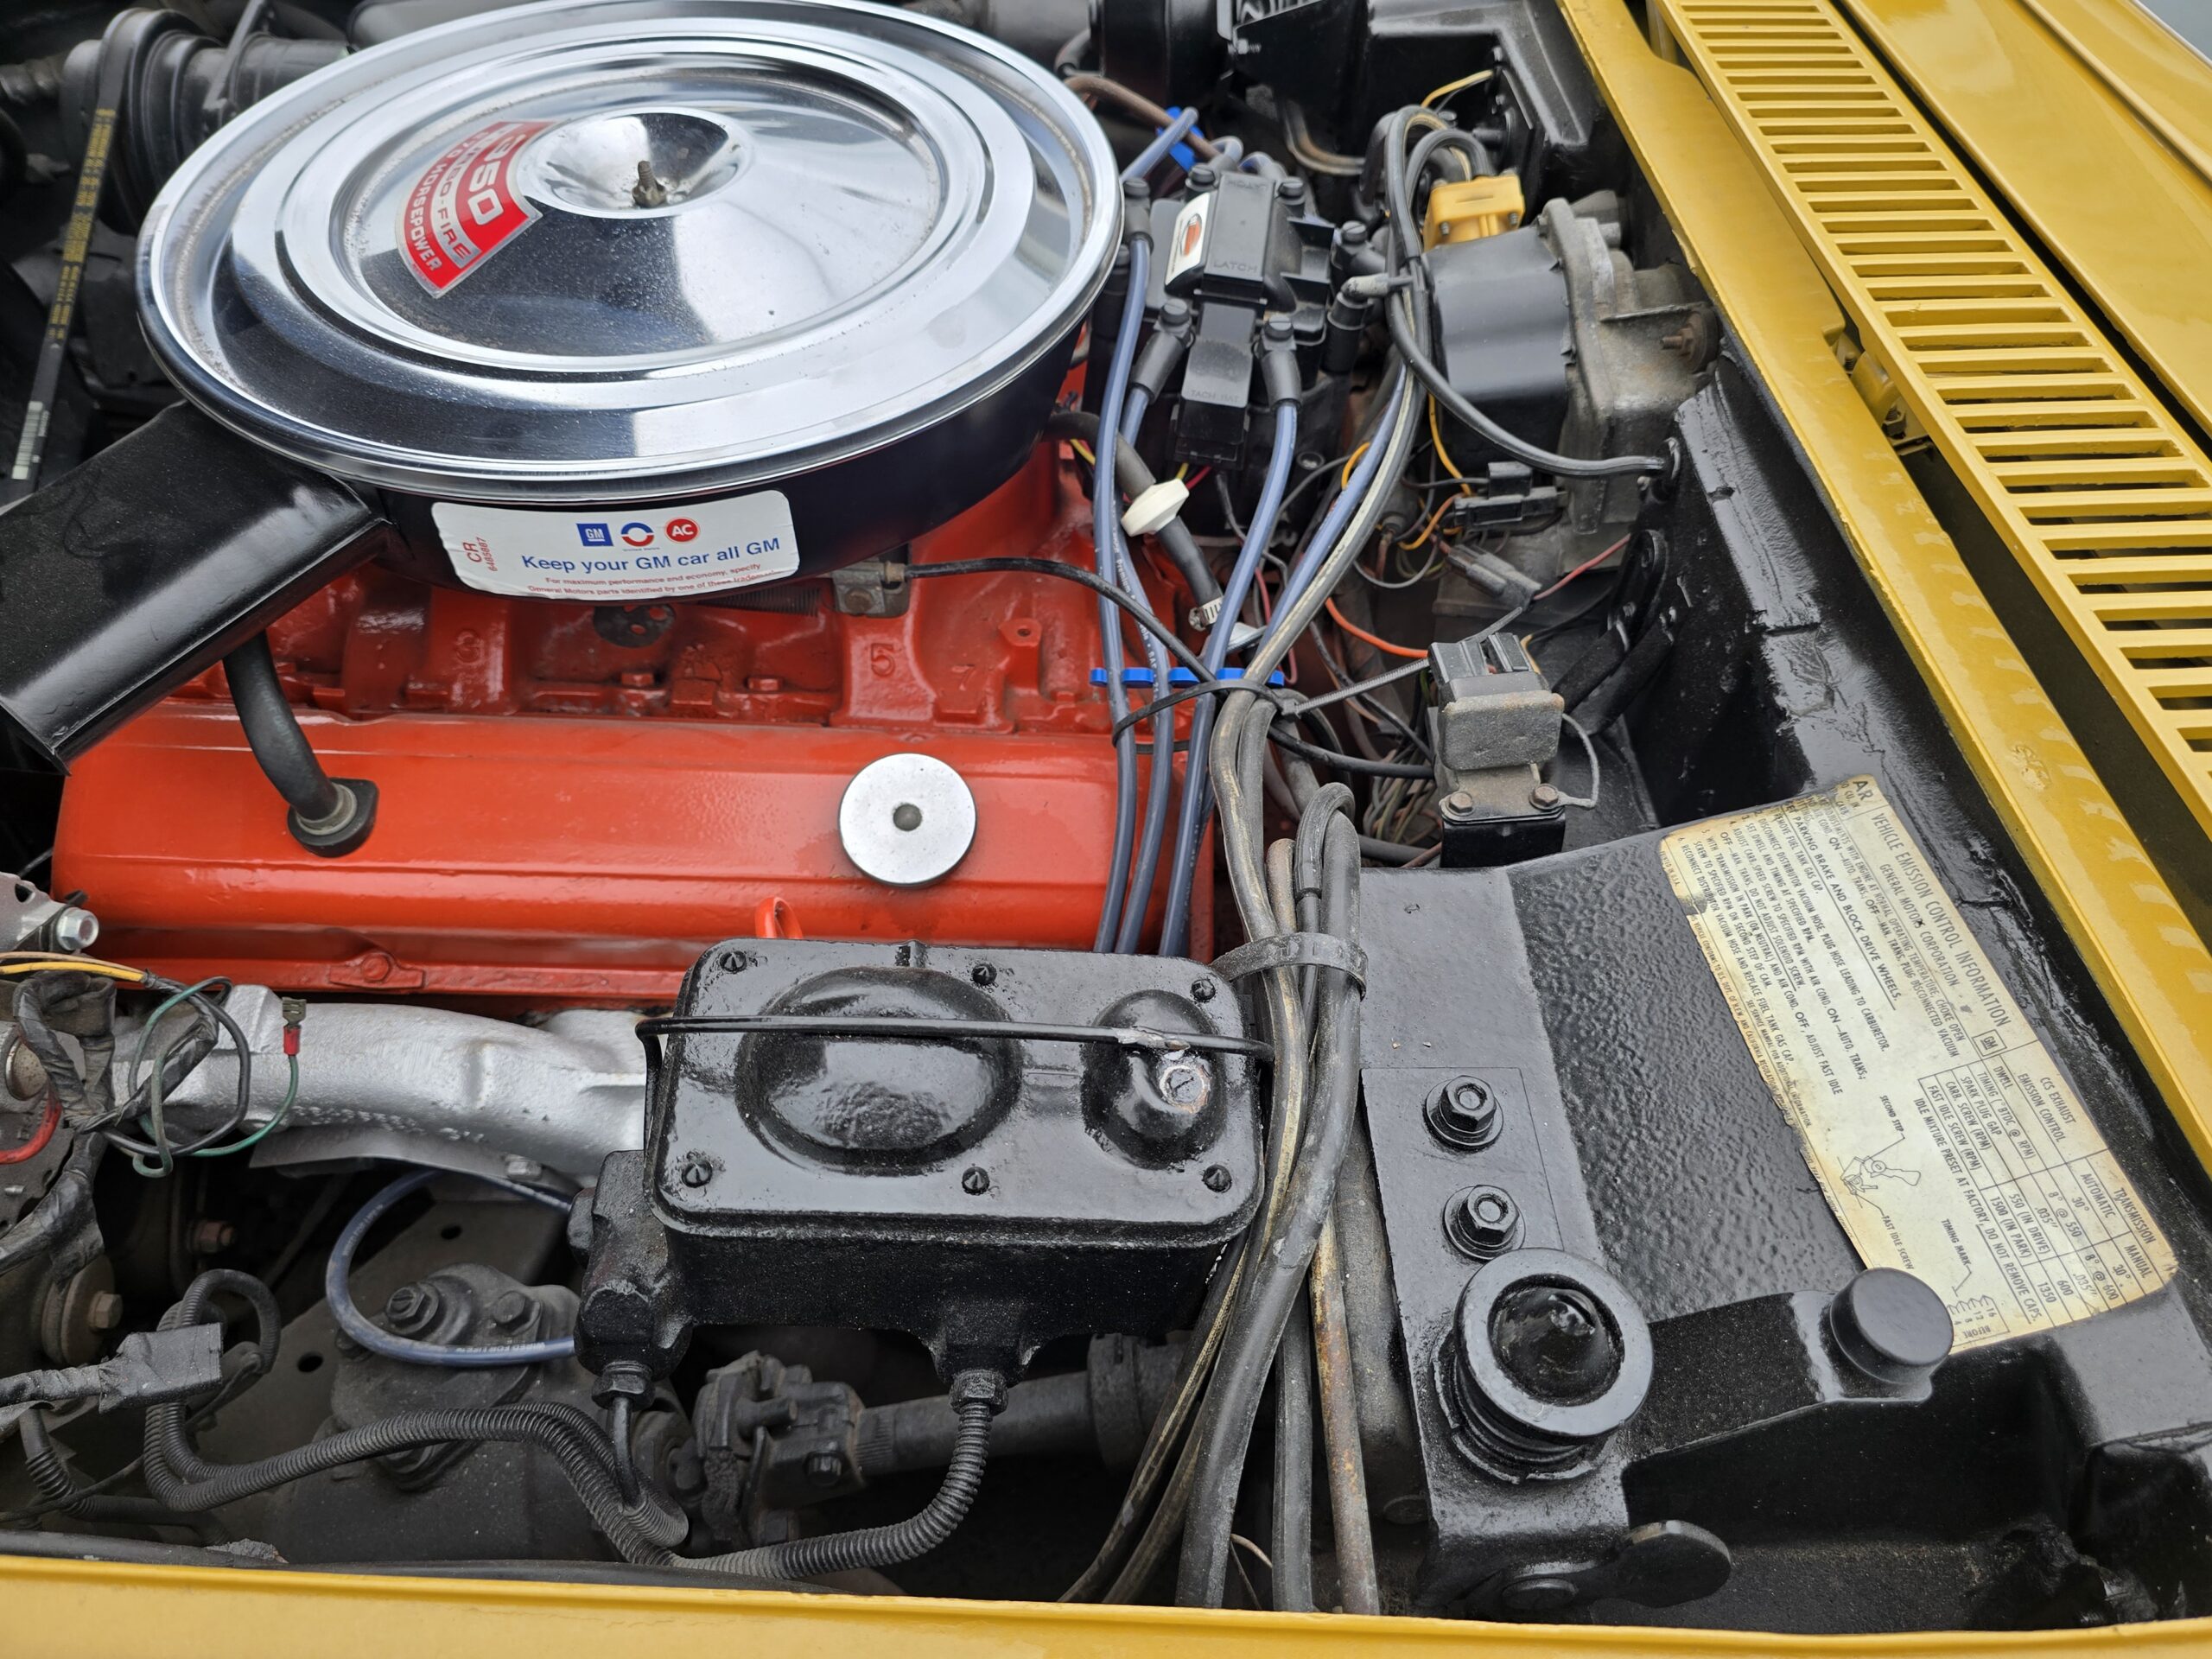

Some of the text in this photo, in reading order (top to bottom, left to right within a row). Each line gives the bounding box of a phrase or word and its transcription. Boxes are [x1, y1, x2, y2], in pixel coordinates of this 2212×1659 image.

[467, 133, 527, 226] 350
[410, 163, 445, 270] HORSEPOWER
[1213, 261, 1258, 273] LATCH
[462, 542, 482, 563] CR
[585, 528, 606, 539] GM
[671, 524, 695, 537] AC
[522, 537, 780, 574] Keep your GM car all GM
[729, 563, 760, 574] specify
[870, 642, 896, 678] 5
[951, 664, 976, 691] 7
[1850, 777, 1877, 801] AR
[1751, 833, 1768, 853] DWELL
[1785, 835, 1816, 880] FUEL TANK GAS
[1719, 830, 1794, 964] OFF DO NOT ADJUST SOLENOID
[1757, 817, 1866, 1007] DISCONNECT DISTRIBUTOR VACUUM PLUG HOSE LEADING TO
[1791, 816, 1904, 1001] PARKING BRAKE AND BLOCK DRIVE WHEELS.
[1870, 812, 2012, 1027] VEHICLE EMISSION CONTROL INFORMATION
[1878, 862, 1960, 987] GENERAL MOTORS CORPORATION
[1745, 945, 1765, 972] STEP OF
[1760, 882, 1841, 1024] SCREW TO WITH AIR ON
[1867, 882, 1966, 1042] AT OPERATING CHOKE OPEN
[1738, 902, 1843, 1095] PARK AIR ADJUST FAST IDLE
[1864, 898, 1961, 1058] OFF VACUUM
[1756, 997, 1788, 1047] FUEL TANK GAS
[1979, 1035, 1999, 1051] GM
[1992, 1065, 2014, 1090] DWELL
[2038, 1076, 2076, 1126] CCS EXHAUST
[1878, 1094, 1904, 1133] SECOND STEP
[1926, 1084, 1982, 1172] FAST IDLE SCREW (RPM)
[1956, 1102, 1993, 1152] SCREW (RPM)
[1959, 1075, 2002, 1137] SPARK PLUG GAP
[1976, 1071, 2037, 1160] TIMING @ RPM)
[2016, 1072, 2067, 1143] EMISSION CONTROL
[1912, 1097, 2044, 1322] IDLE MIXTURE PRESET AT FACTORY, DO NOT REMOVE CAPS.
[2080, 1172, 2116, 1218] AUTOMATIC
[2112, 1186, 2157, 1245] TRANSMISSION
[1880, 1215, 1915, 1271] FAST IDLE SCREW
[1940, 1217, 1972, 1267] TIMING MARK
[1988, 1195, 2033, 1260] 1500 (IN PARK)
[2007, 1192, 2051, 1256] 550 (IN DRIVE)
[2053, 1206, 2069, 1219] @
[2063, 1220, 2082, 1238] 550
[2089, 1269, 2106, 1283] @
[2101, 1282, 2120, 1300] 600
[2124, 1243, 2153, 1279] MANUAL
[2036, 1281, 2057, 1305] 1350
[2056, 1278, 2074, 1297] 600
[1961, 1323, 1991, 1341] BEFORE
[1972, 1310, 1984, 1321] 12
[1985, 1306, 1997, 1318] 16
